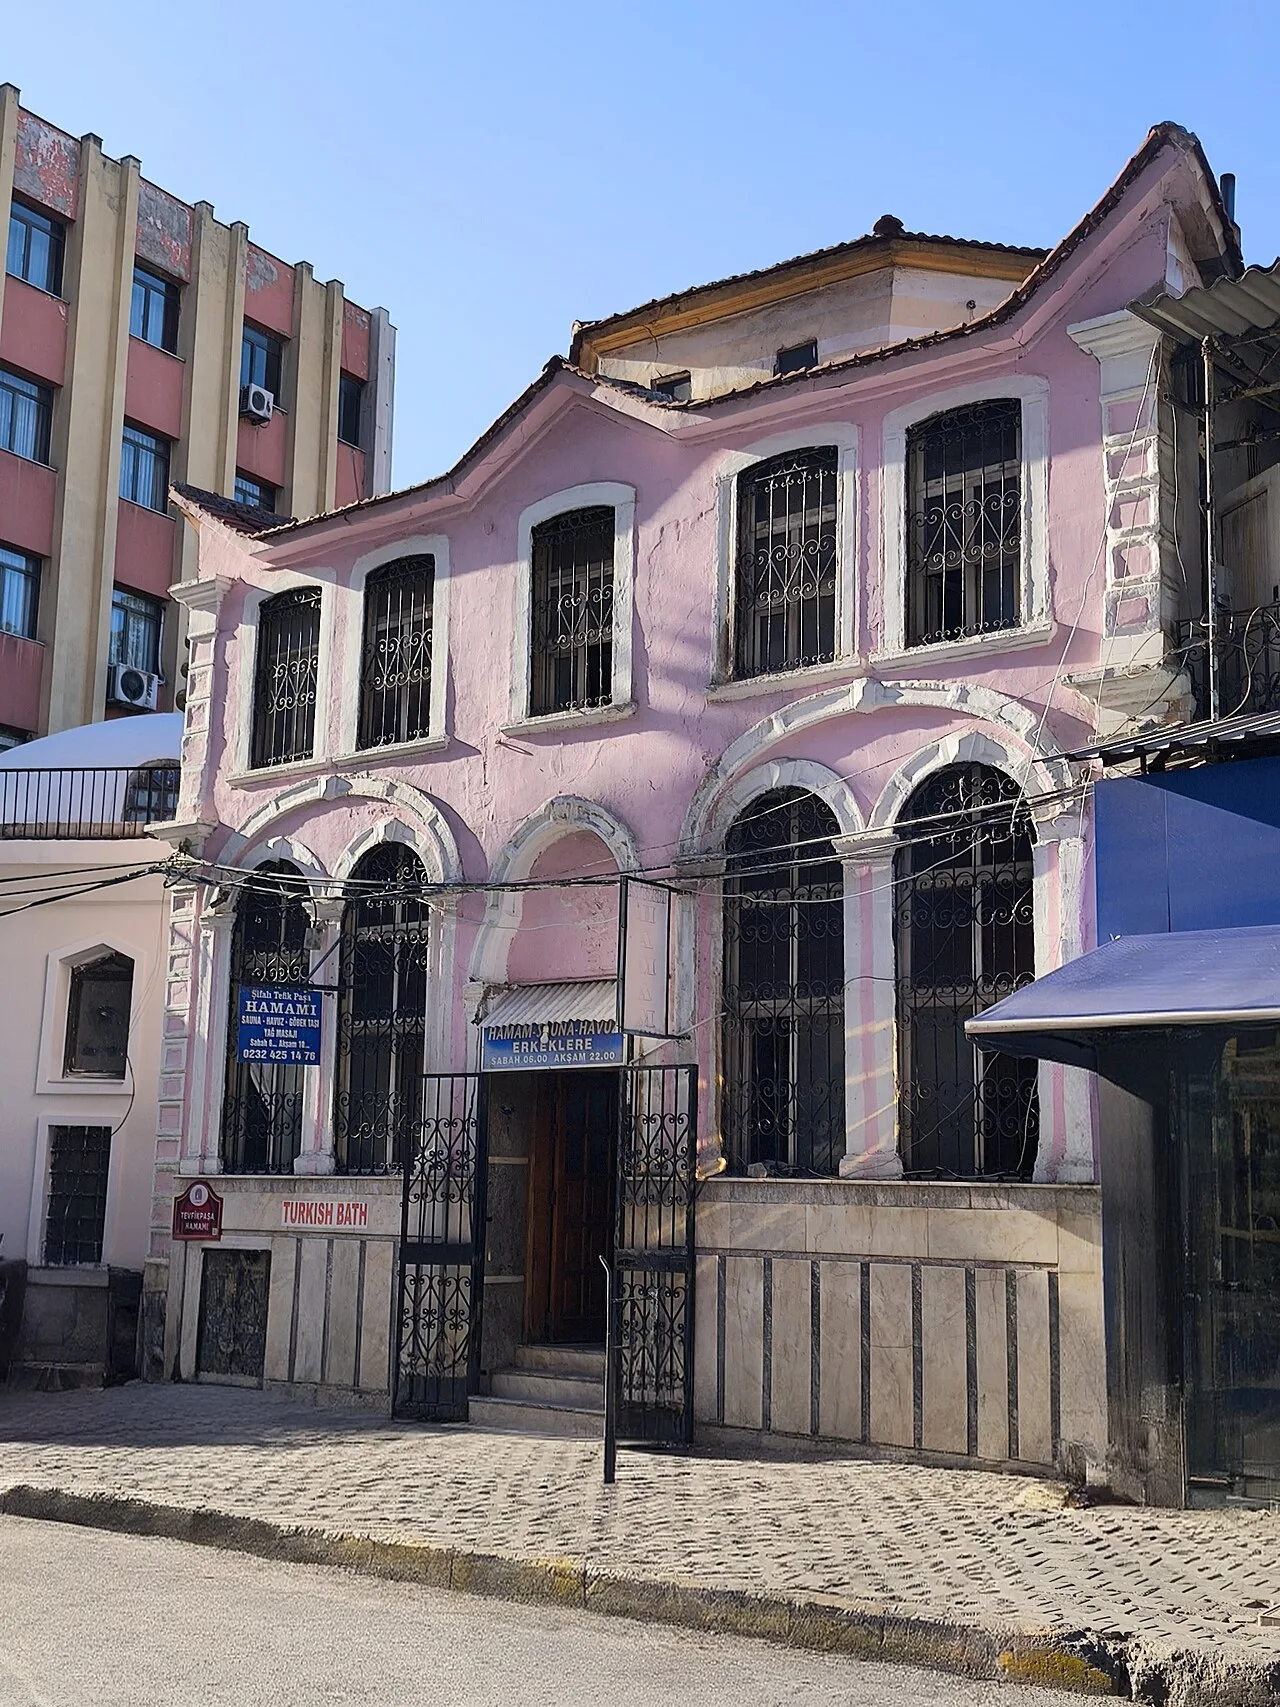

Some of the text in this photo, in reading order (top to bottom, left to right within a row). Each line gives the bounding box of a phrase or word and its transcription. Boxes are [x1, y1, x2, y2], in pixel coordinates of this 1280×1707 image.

[245, 1000, 317, 1016] HAMAMI
[241, 1015, 262, 1025] SAUNA
[266, 1016, 285, 1027] HAVUZ
[289, 1016, 307, 1028] GÖBEK
[264, 1027, 298, 1039] YAĞ MASAJI
[249, 1038, 268, 1047] Sabah
[279, 1040, 298, 1049] Akşam
[512, 1038, 593, 1053] ERKEKLERE
[243, 1049, 316, 1061] 0232 425 14 76
[491, 1054, 521, 1065] SABAH
[554, 1052, 586, 1064] AKŞAM
[589, 1051, 616, 1061] 22.00
[283, 1201, 368, 1226] TURKISH BATH
